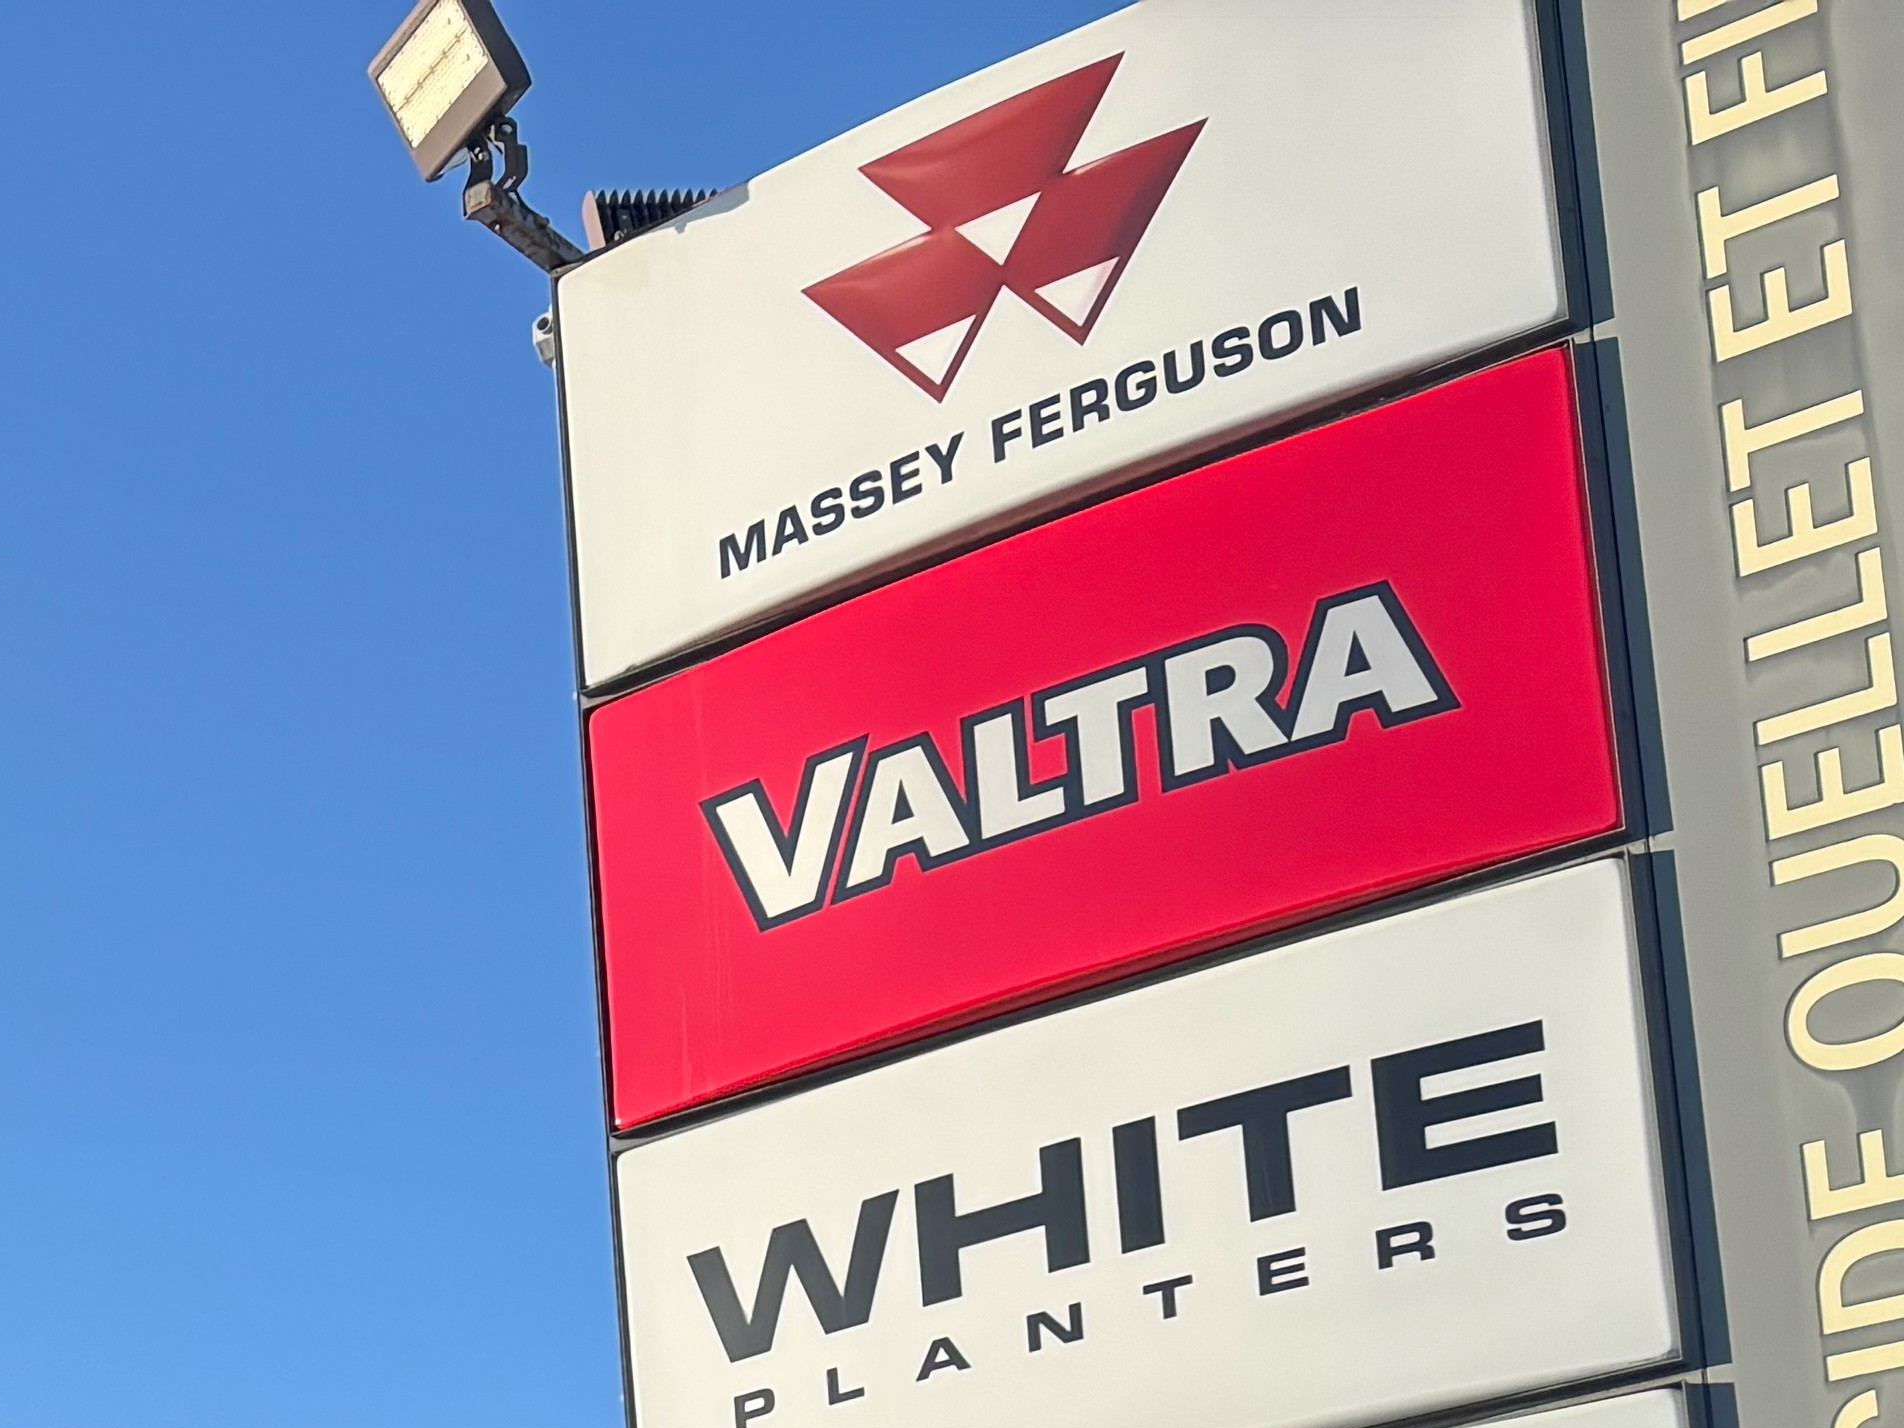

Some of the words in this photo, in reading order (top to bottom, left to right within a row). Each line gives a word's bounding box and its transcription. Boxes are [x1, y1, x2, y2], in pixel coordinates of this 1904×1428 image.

[1676, 0, 1828, 146] FI
[1696, 173, 1853, 363] ET
[717, 431, 965, 579] MASSEY
[991, 287, 1364, 463] FERGUSON
[703, 582, 1456, 930] VALTRA
[1721, 389, 1904, 1072] OUELLET
[685, 1018, 1559, 1363] WHITE
